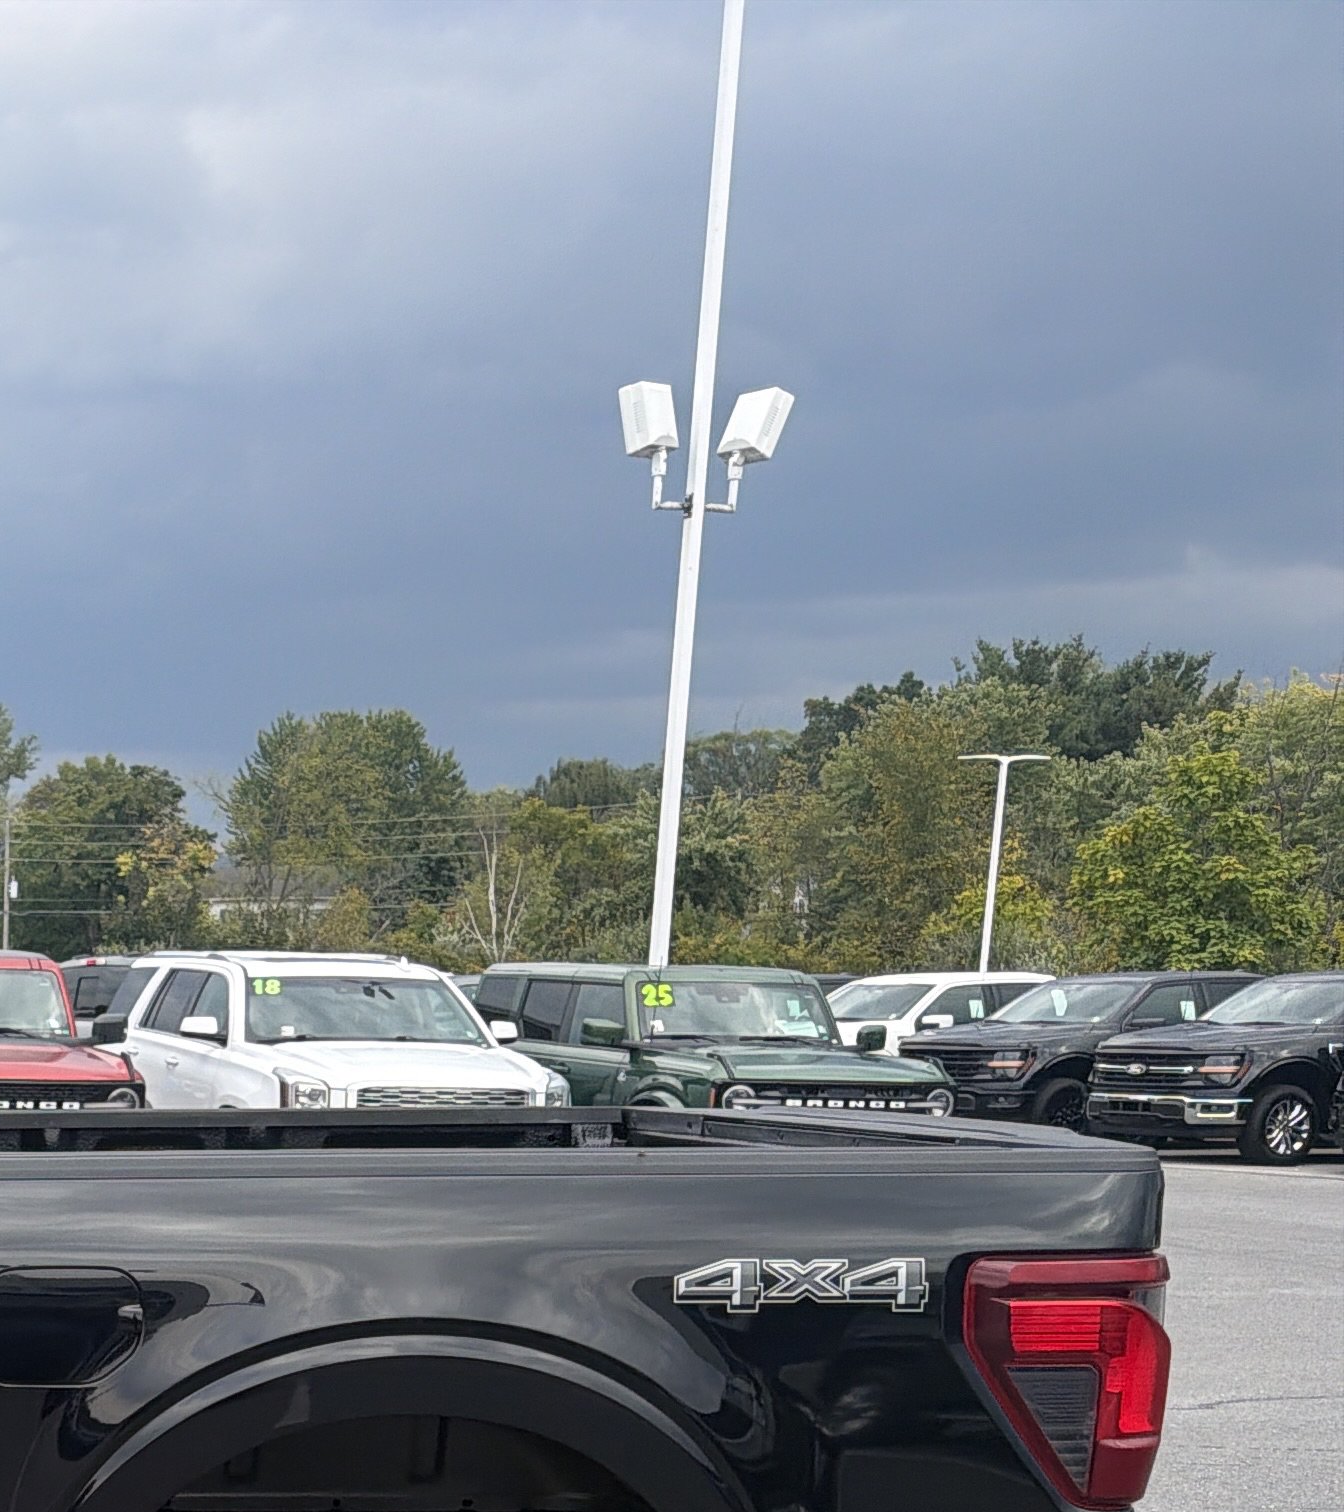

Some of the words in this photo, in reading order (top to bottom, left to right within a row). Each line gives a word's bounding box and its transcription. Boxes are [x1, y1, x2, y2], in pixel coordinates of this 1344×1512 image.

[252, 979, 281, 995] 18
[641, 983, 673, 1007] 25
[785, 1097, 906, 1109] BRONCO
